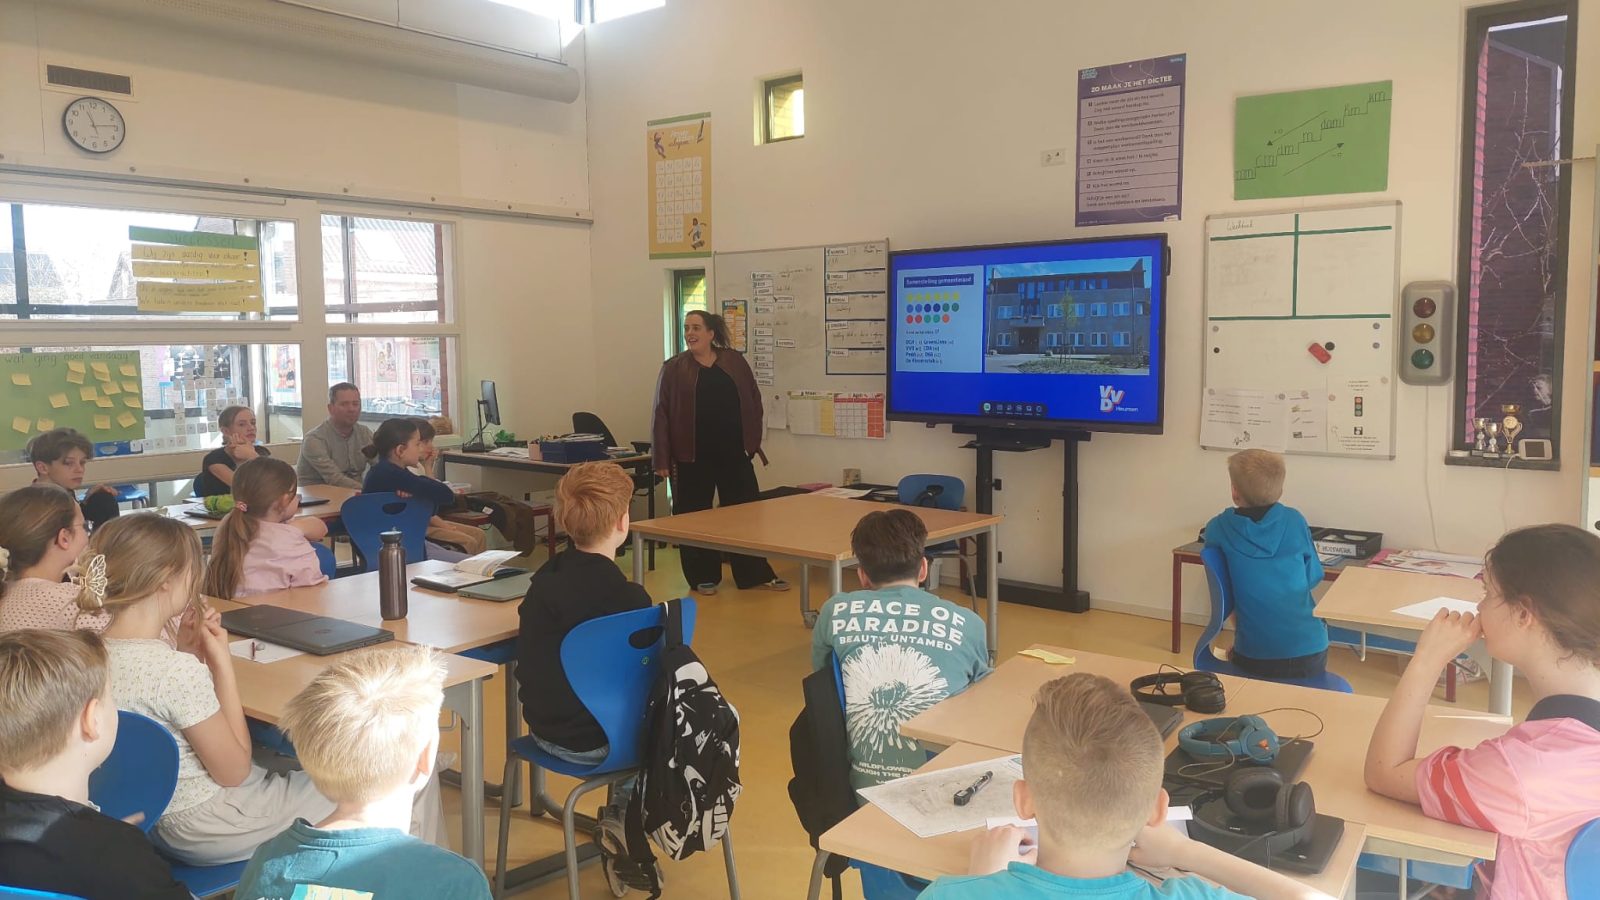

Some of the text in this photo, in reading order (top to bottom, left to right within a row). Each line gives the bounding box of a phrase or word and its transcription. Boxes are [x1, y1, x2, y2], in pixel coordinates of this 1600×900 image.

[1102, 82, 1121, 91] MAAK
[1148, 75, 1173, 84] DICTEE
[832, 600, 966, 627] PEACE OF
[832, 617, 964, 645] PARADISE
[840, 634, 952, 651] BEAUTY UNTAMED
